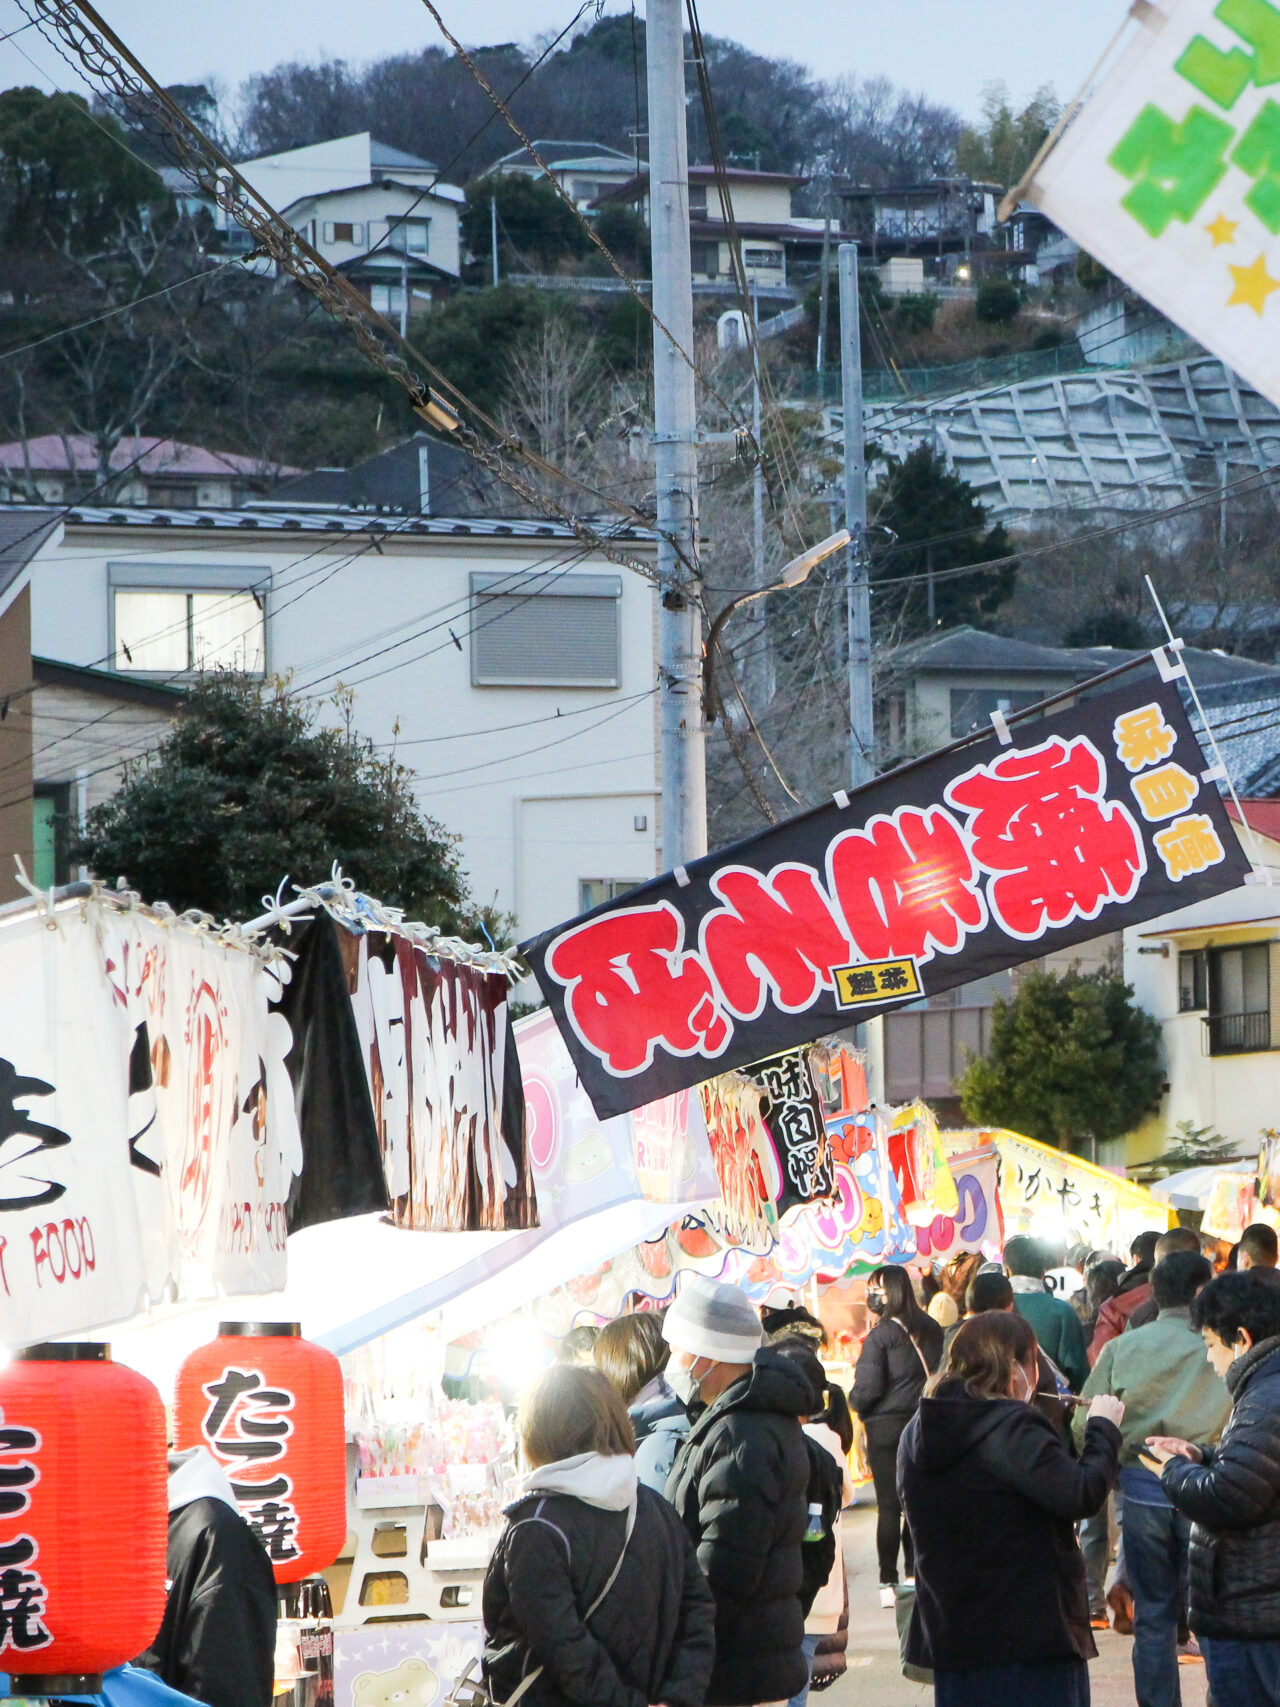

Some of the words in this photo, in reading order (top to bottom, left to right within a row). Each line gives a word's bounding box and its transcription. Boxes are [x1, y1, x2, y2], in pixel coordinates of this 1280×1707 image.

[1112, 702, 1225, 881] 味自慢
[547, 736, 1142, 1076] 焼きそば
[846, 966, 909, 997] 特製
[206, 1370, 300, 1562] たこ焼
